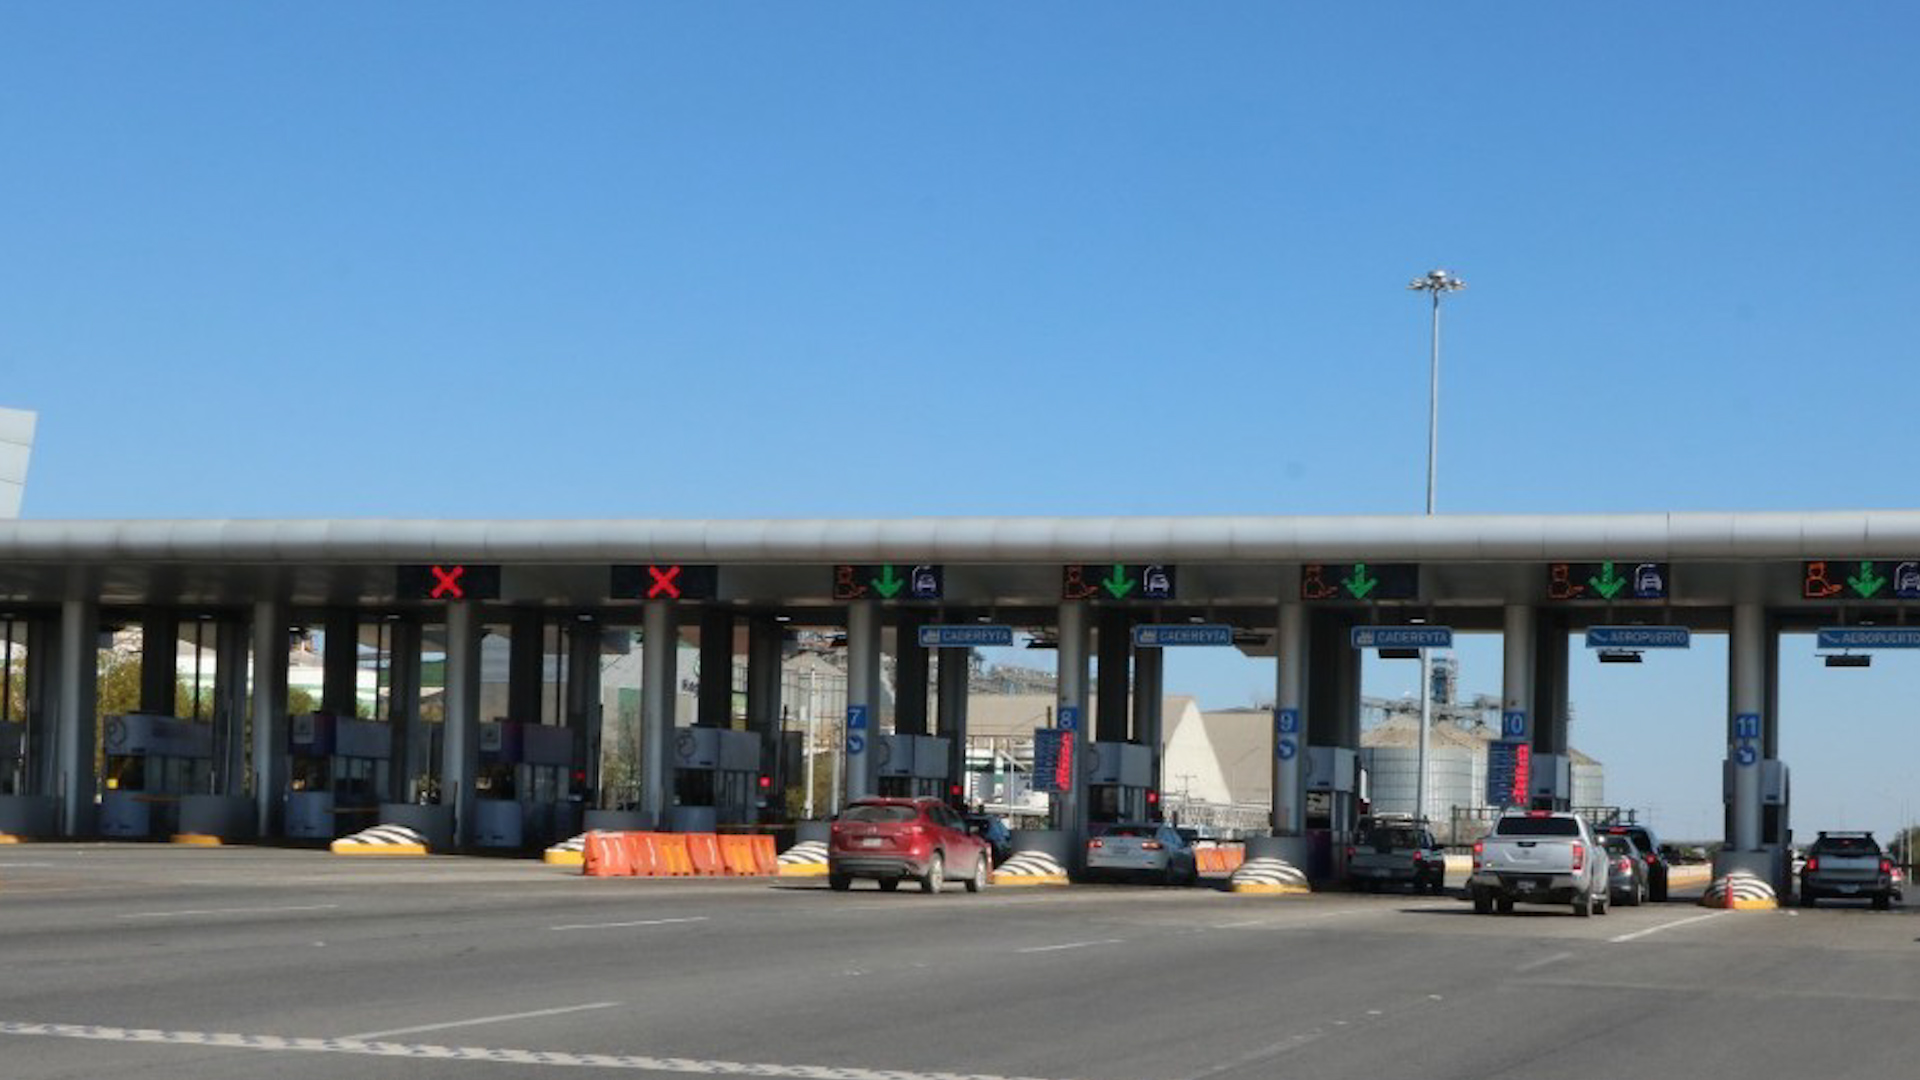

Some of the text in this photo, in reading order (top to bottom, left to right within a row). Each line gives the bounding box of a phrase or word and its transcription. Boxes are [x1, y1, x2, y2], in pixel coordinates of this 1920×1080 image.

[944, 630, 1009, 640] CADEREYTA
[1160, 630, 1227, 641] CADEREYTA
[1377, 631, 1448, 643] CADEREYTA
[1610, 631, 1686, 643] AEROPUERTO
[849, 709, 861, 726] 7
[1060, 710, 1072, 728] 8
[1280, 712, 1293, 731] 9
[1504, 714, 1523, 734] 10
[1737, 717, 1756, 736] 11
